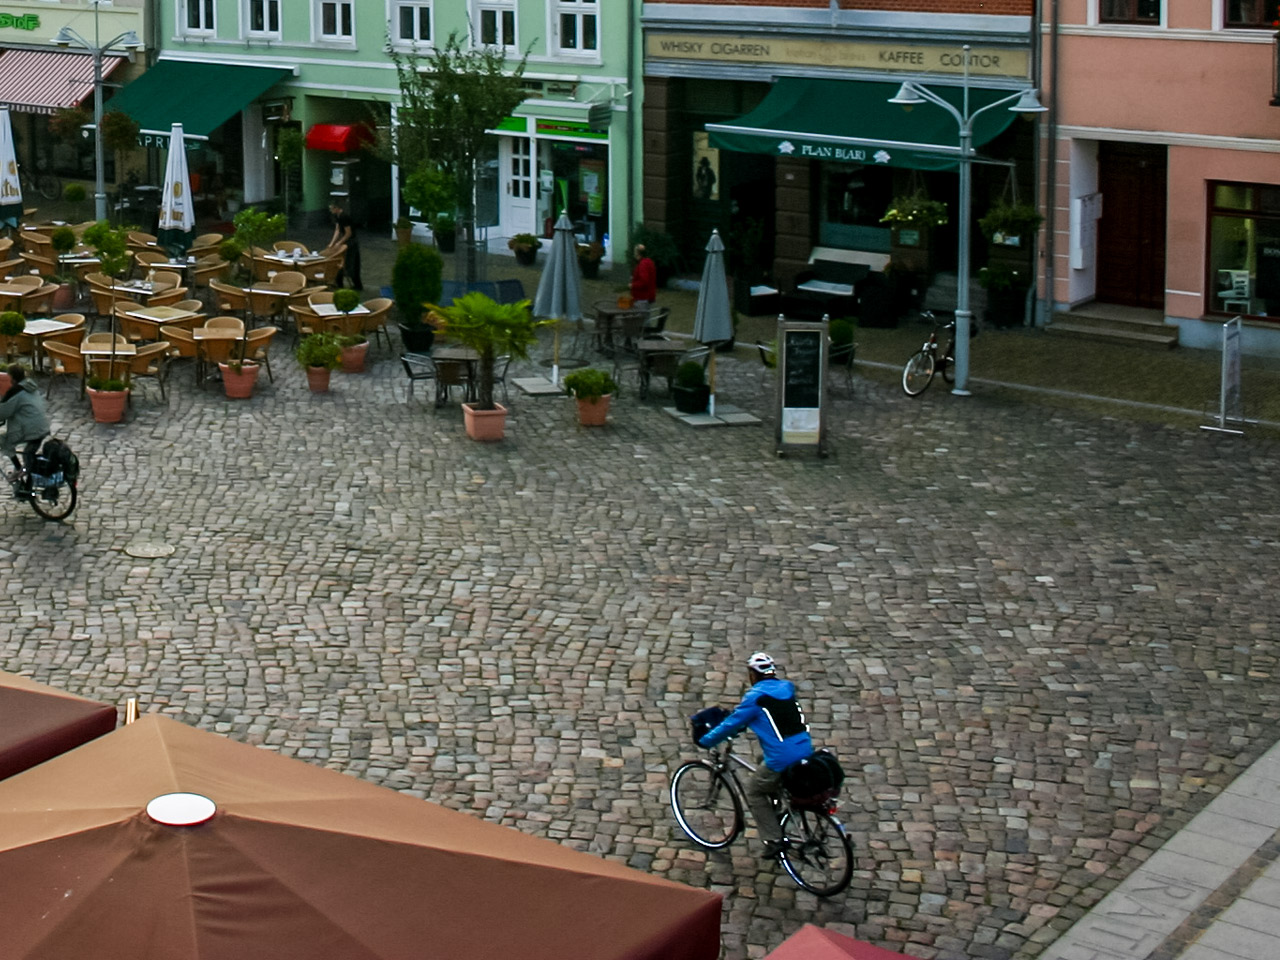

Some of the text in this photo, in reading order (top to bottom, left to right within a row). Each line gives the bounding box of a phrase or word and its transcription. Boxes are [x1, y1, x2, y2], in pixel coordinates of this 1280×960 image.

[661, 41, 704, 53] WHISKY
[710, 42, 770, 56] CIGARREN
[879, 51, 924, 65] KAFFEE
[802, 145, 866, 160] PLAN B(AR)
